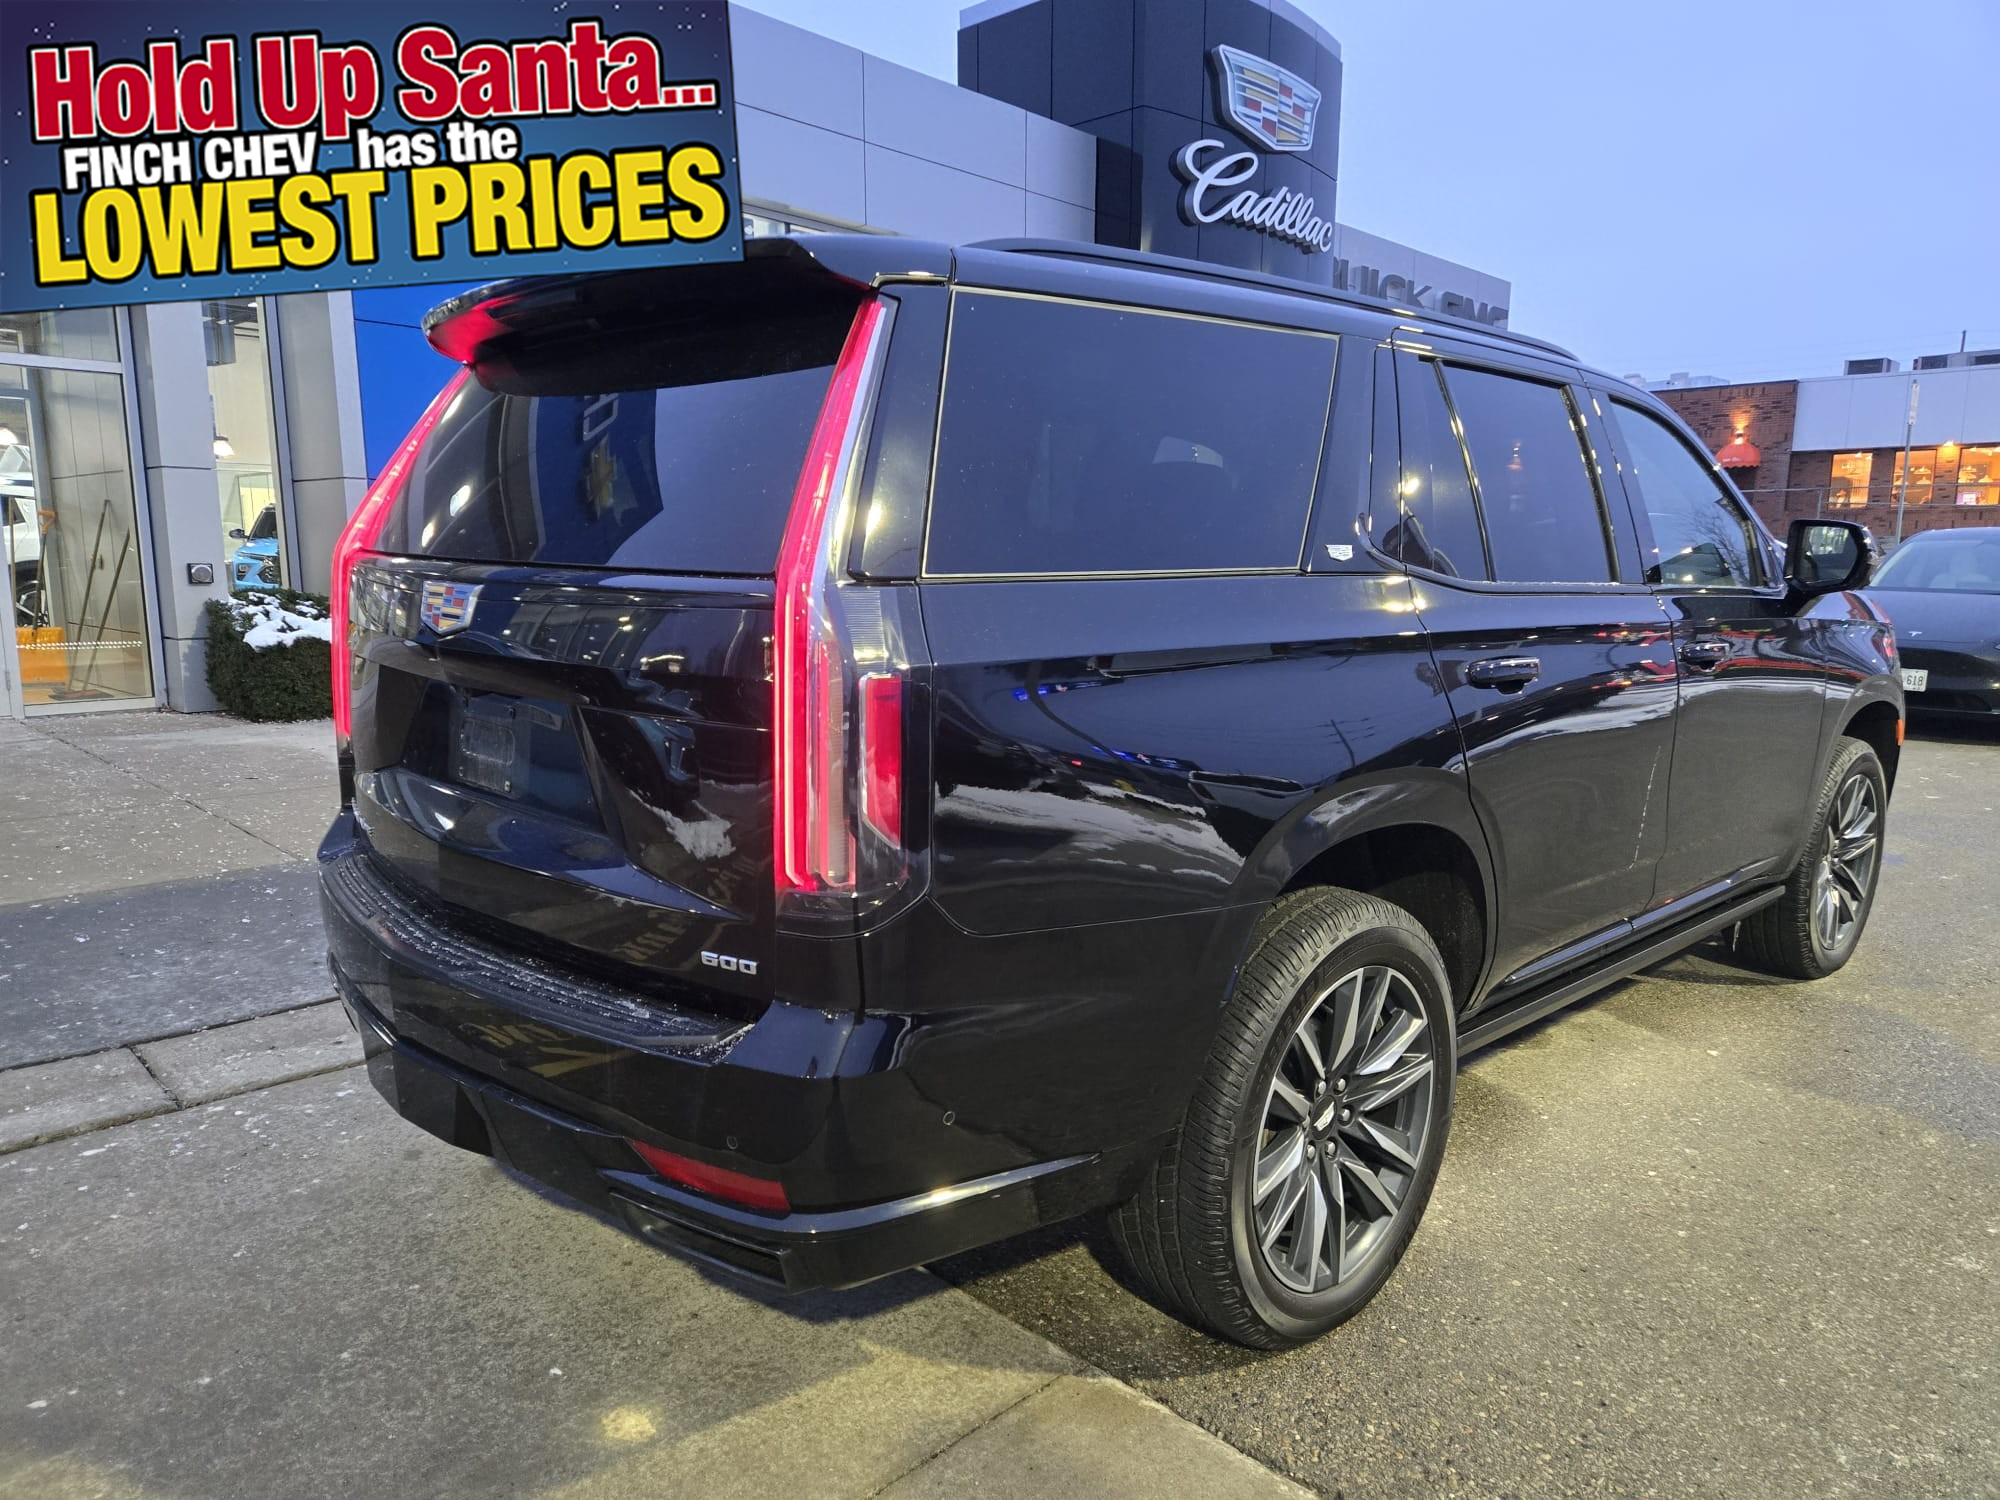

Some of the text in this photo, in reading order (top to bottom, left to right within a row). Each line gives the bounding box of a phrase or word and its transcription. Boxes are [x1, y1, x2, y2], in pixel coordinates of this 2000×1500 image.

[1174, 137, 1333, 253] Cadillac
[1332, 256, 1433, 311] UICK
[700, 950, 758, 975] 600
